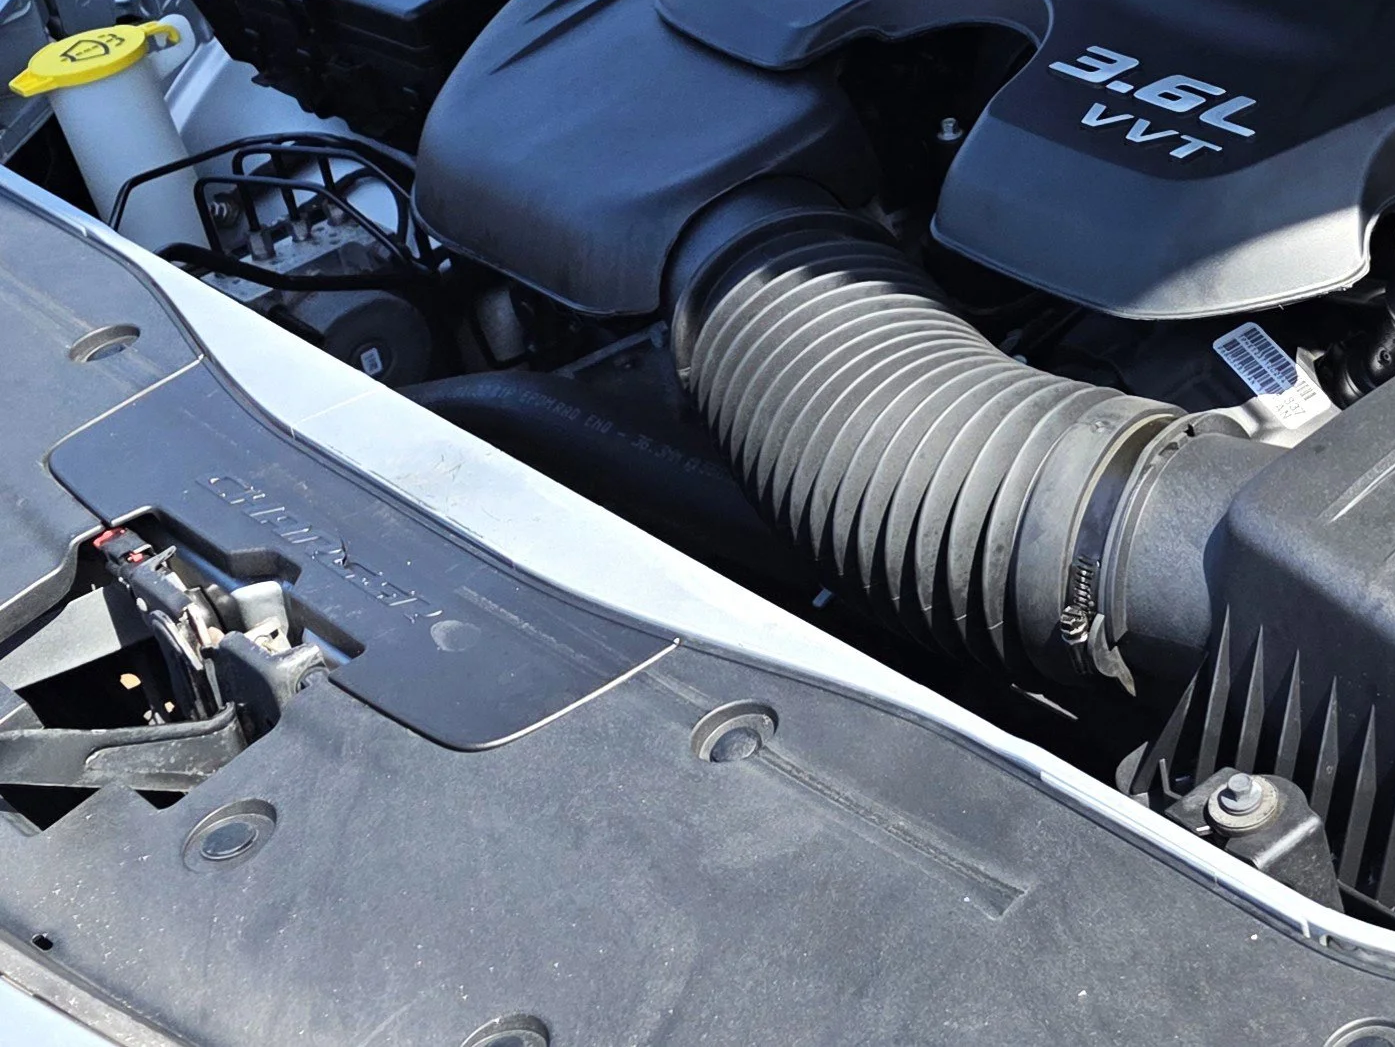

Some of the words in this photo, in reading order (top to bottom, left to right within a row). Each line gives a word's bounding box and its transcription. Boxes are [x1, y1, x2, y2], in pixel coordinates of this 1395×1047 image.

[1048, 45, 1257, 138] 3.6L
[1080, 102, 1223, 159] VVT
[195, 474, 444, 625] CHARGER
